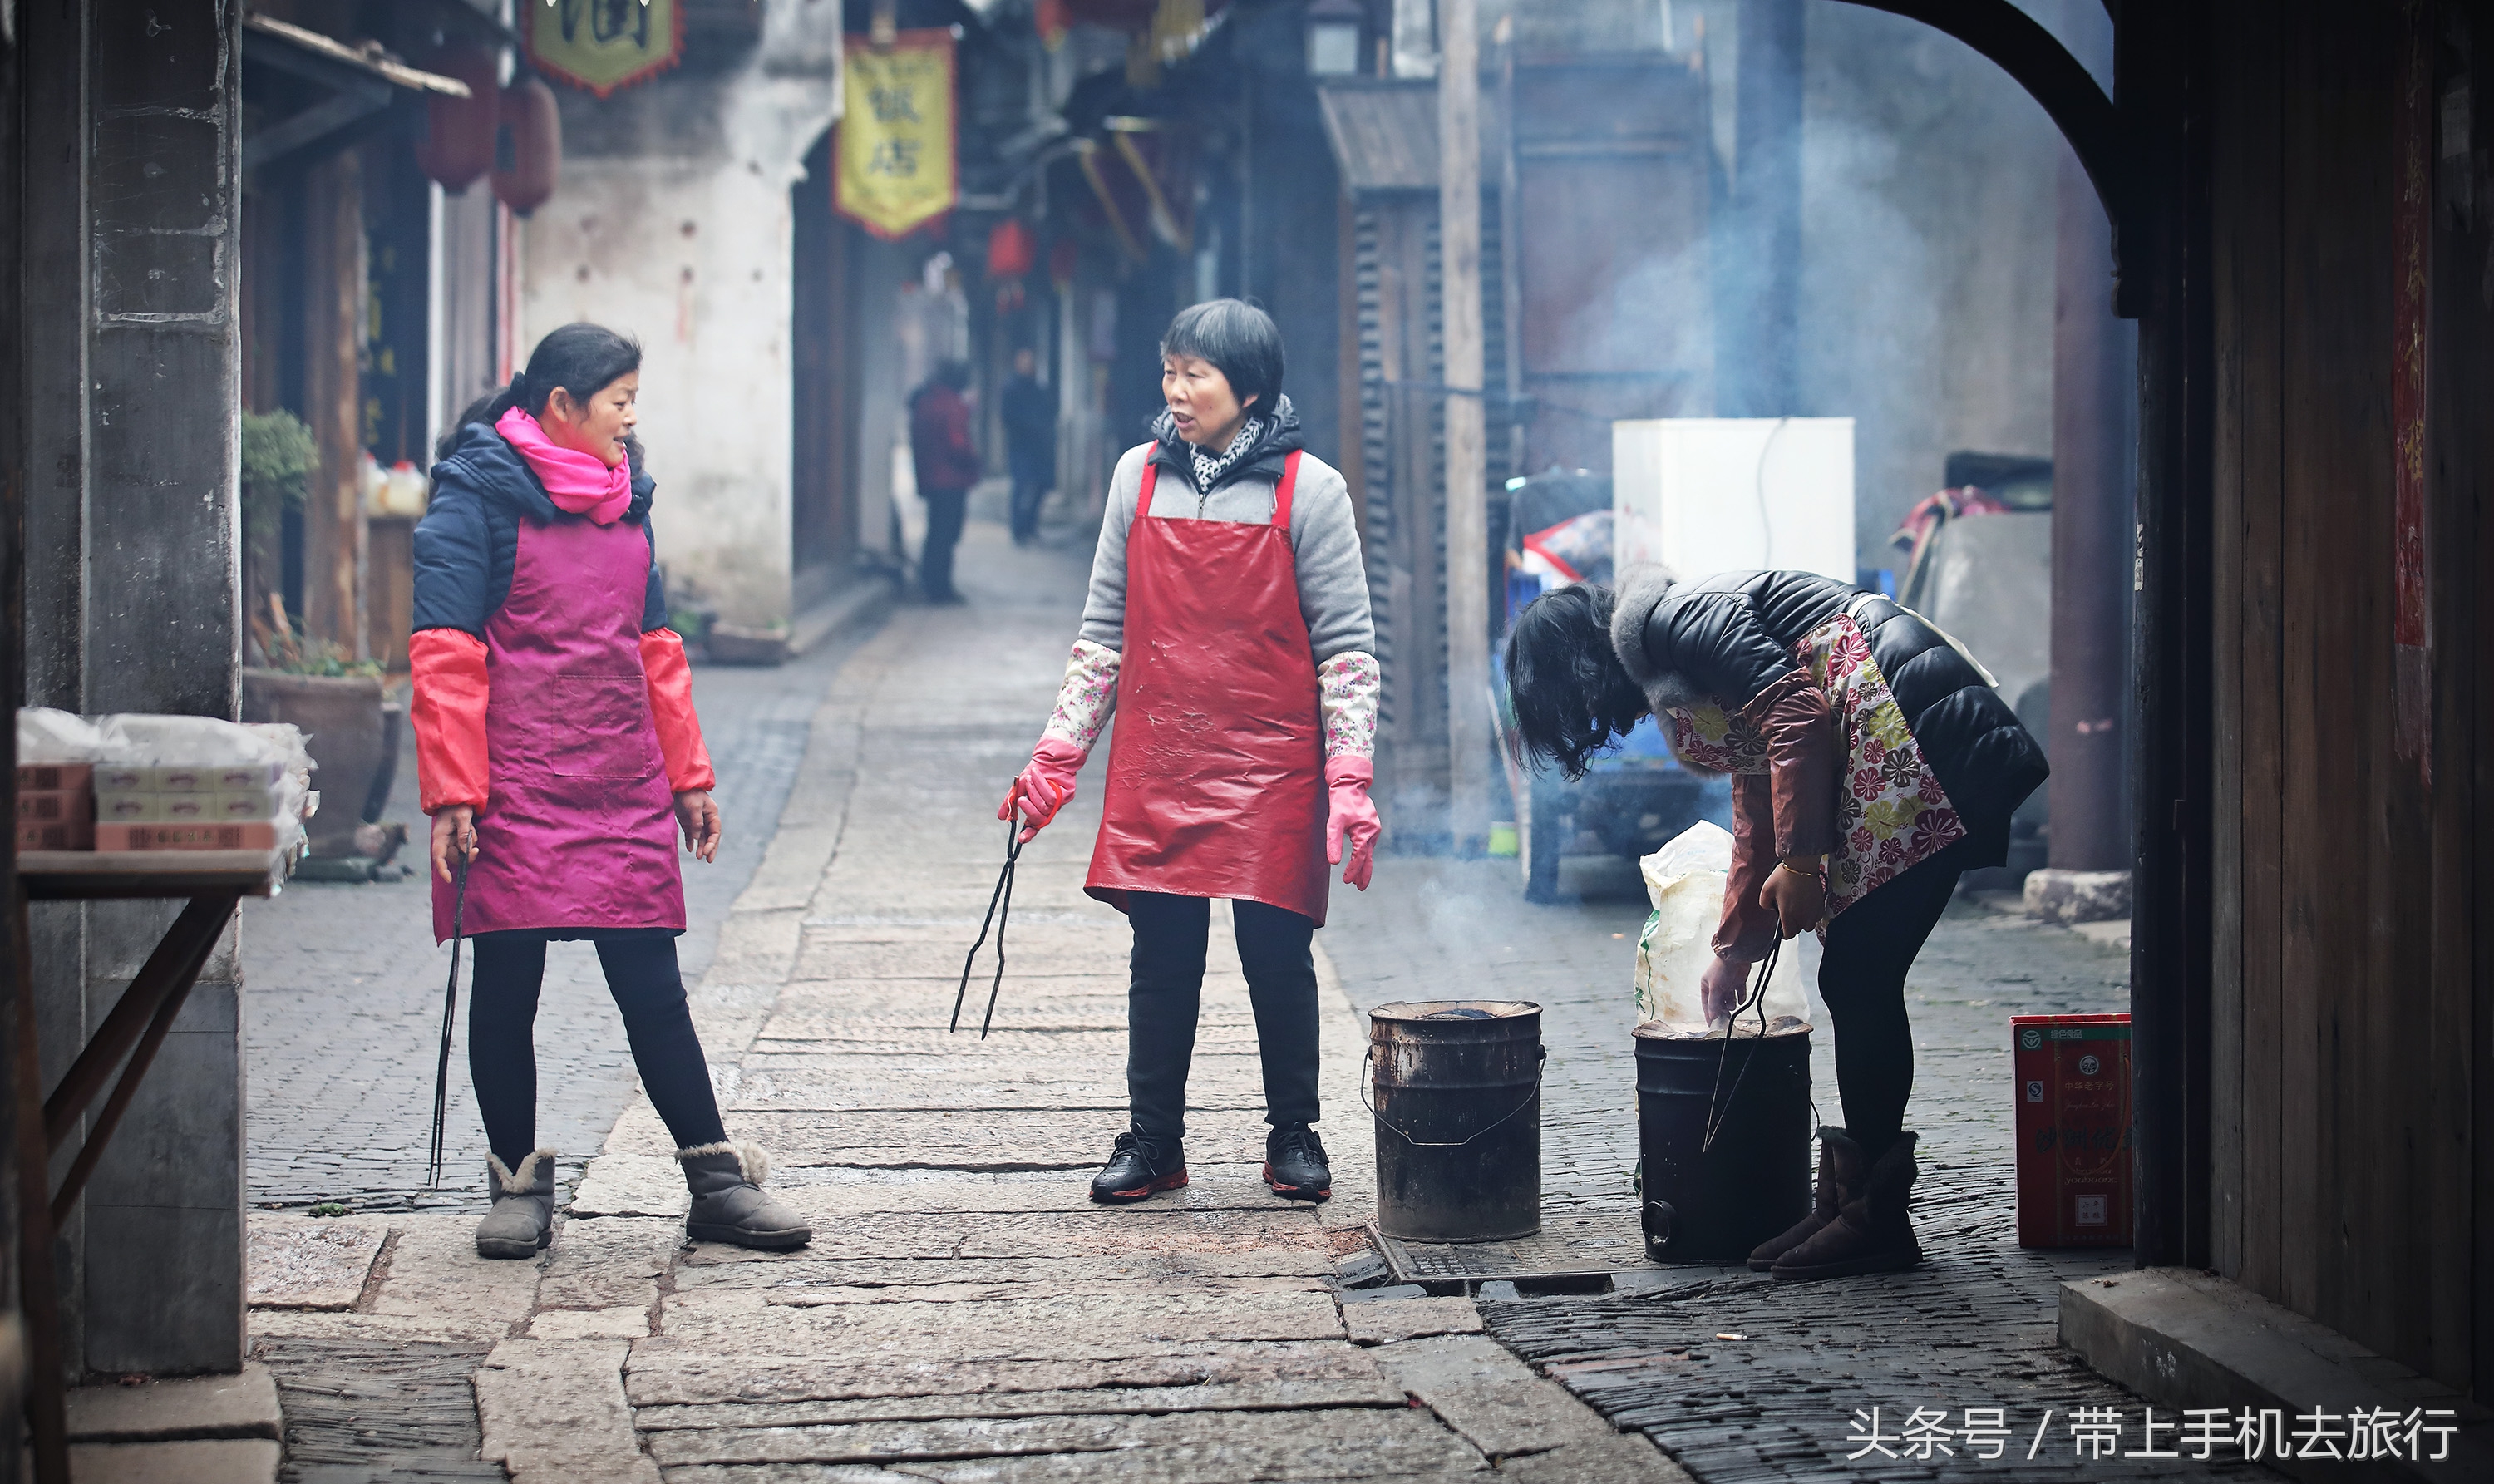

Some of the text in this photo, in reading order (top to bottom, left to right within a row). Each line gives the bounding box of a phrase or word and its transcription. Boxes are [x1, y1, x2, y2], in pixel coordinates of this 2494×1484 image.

[2050, 1029, 2082, 1039] 绿色食品
[2064, 1080, 2115, 1091] 中华老字号
